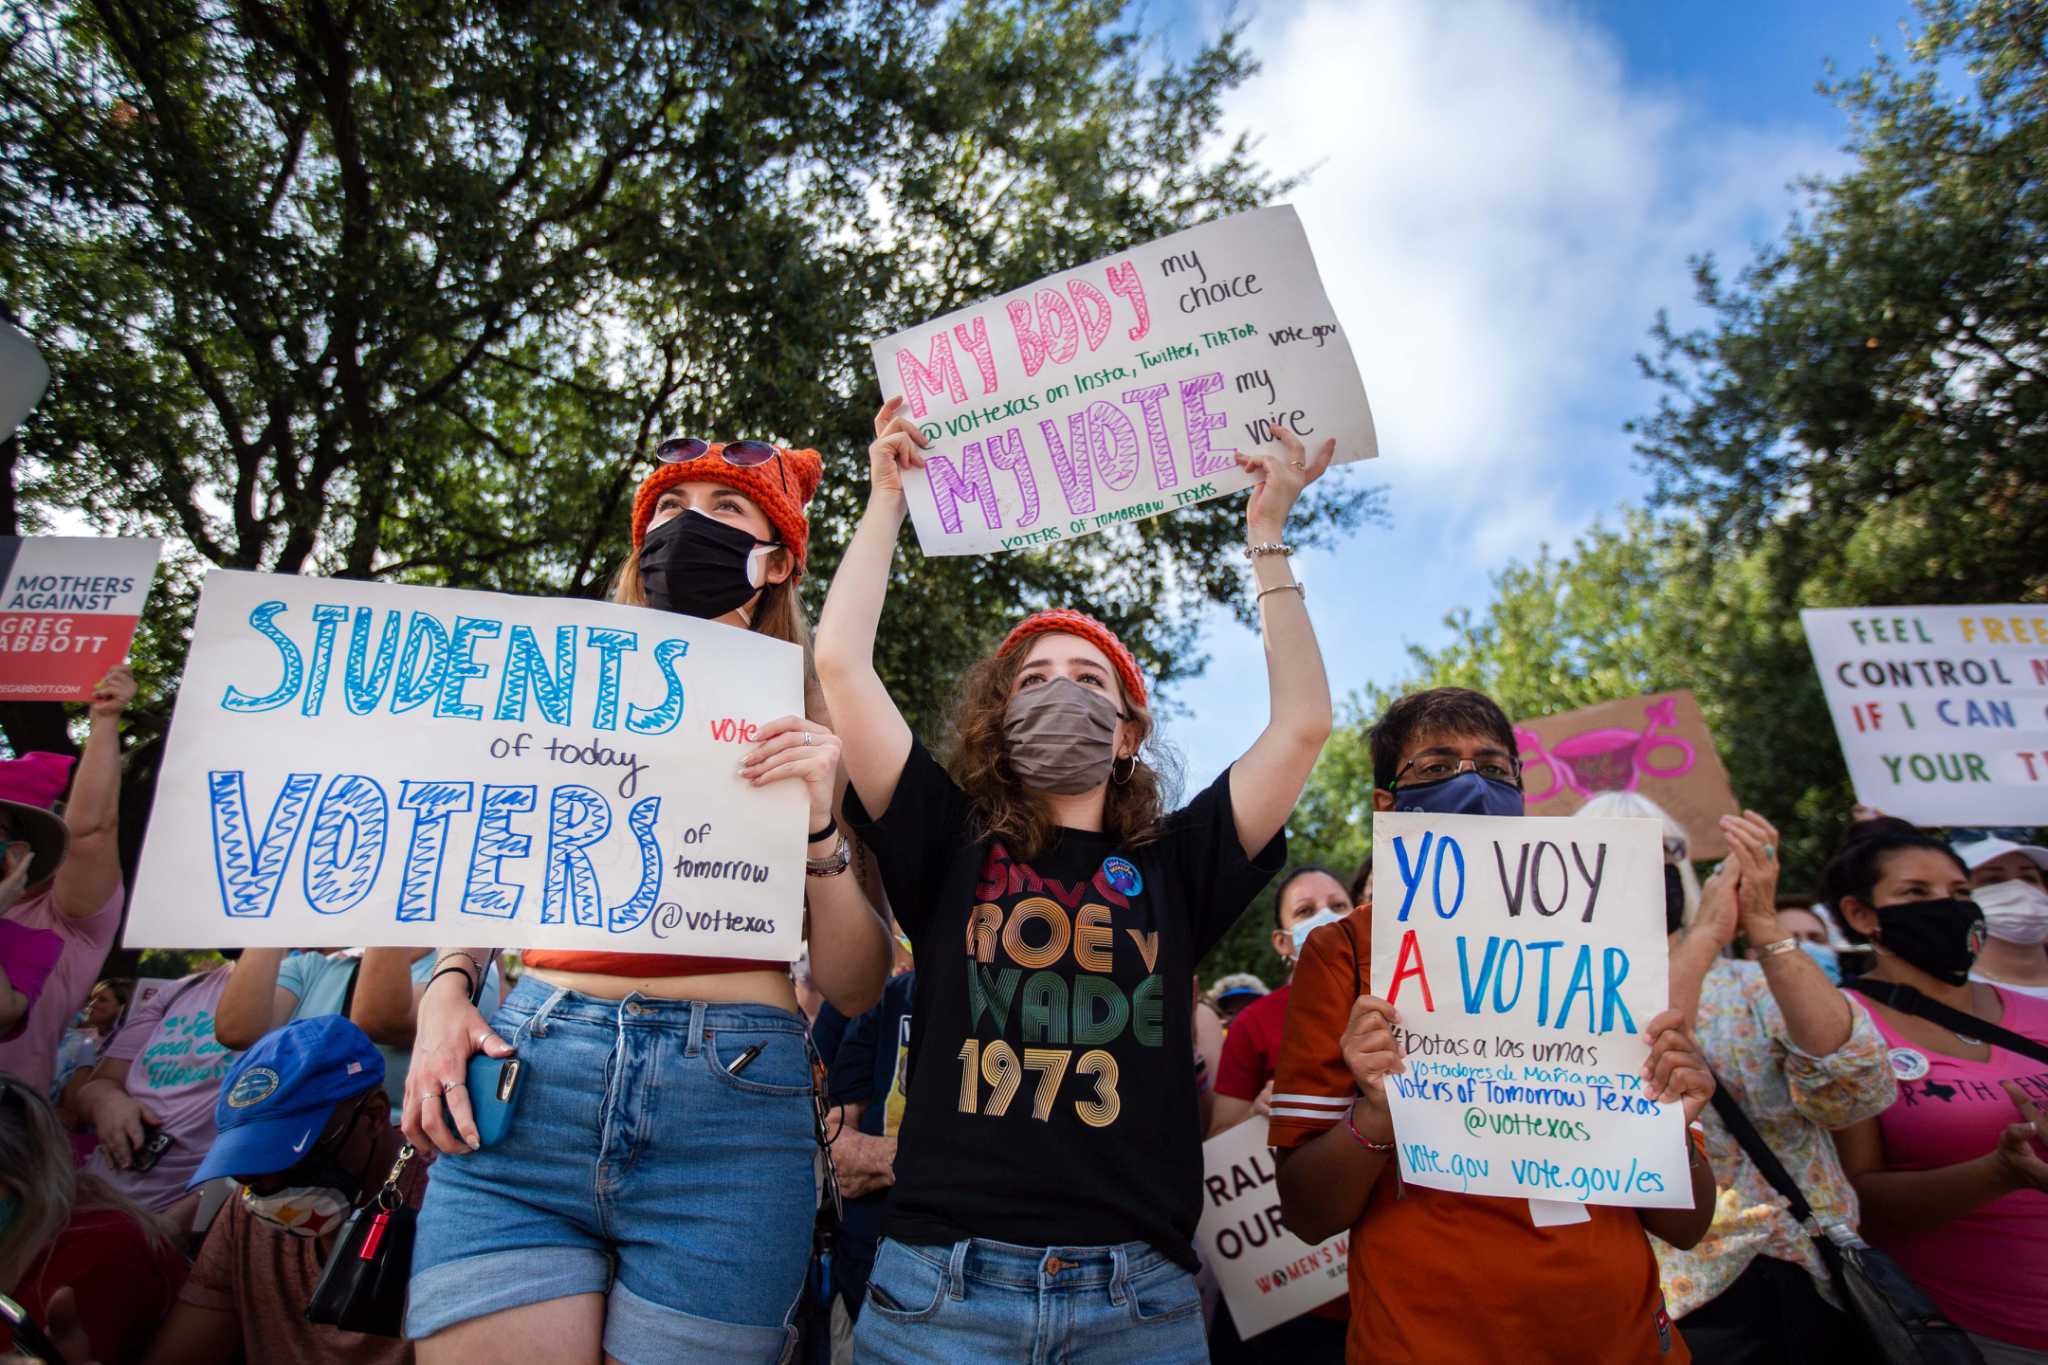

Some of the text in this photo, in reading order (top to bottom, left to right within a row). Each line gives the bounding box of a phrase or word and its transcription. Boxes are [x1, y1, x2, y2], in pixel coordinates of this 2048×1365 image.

[1160, 249, 1206, 282] my
[1179, 271, 1263, 314] choice
[896, 260, 1151, 419] MY BODY
[1046, 383, 1070, 404] on
[1075, 365, 1138, 393] Insta,
[1135, 342, 1200, 369] Twitter,
[1236, 367, 1275, 405] my
[924, 371, 1240, 534] MY VOTE
[1001, 482, 1217, 550] VOTERS OF TOMORROW TEXAS
[8, 593, 117, 610] AGAINST
[16, 575, 135, 593] MOTHERS
[0, 635, 108, 653] ABBOTT
[1, 618, 74, 635] GREG
[1850, 617, 2048, 645] FEEL FREE
[221, 601, 690, 735] STUDENTS
[1837, 658, 2013, 688] CONTROL
[0, 683, 81, 695] EGABBOTT.COM
[1852, 703, 1883, 733] IF
[1900, 702, 1916, 729] I
[1936, 699, 2017, 728] CAN
[489, 733, 650, 799] of today
[1881, 753, 1991, 784] YOUR
[208, 770, 663, 934] VOTERS
[684, 823, 712, 844] of
[674, 855, 769, 883] tomorrow
[1392, 831, 1608, 923] YO VOY
[965, 896, 1113, 973] ROE
[1386, 929, 1639, 1035] A VOTAR
[966, 958, 1164, 1047] WADE
[1473, 1040, 1488, 1056] a
[1495, 1036, 1525, 1059] las
[957, 1038, 1121, 1127] 1973
[1497, 1063, 1517, 1081] de
[1523, 1066, 1613, 1086] Mañana
[1616, 1074, 1642, 1090] TX
[1457, 1077, 1477, 1104] of
[1480, 1080, 1586, 1108] Tomorrow
[1588, 1084, 1661, 1117] Texas
[1511, 1158, 1665, 1201] vote.gov/es
